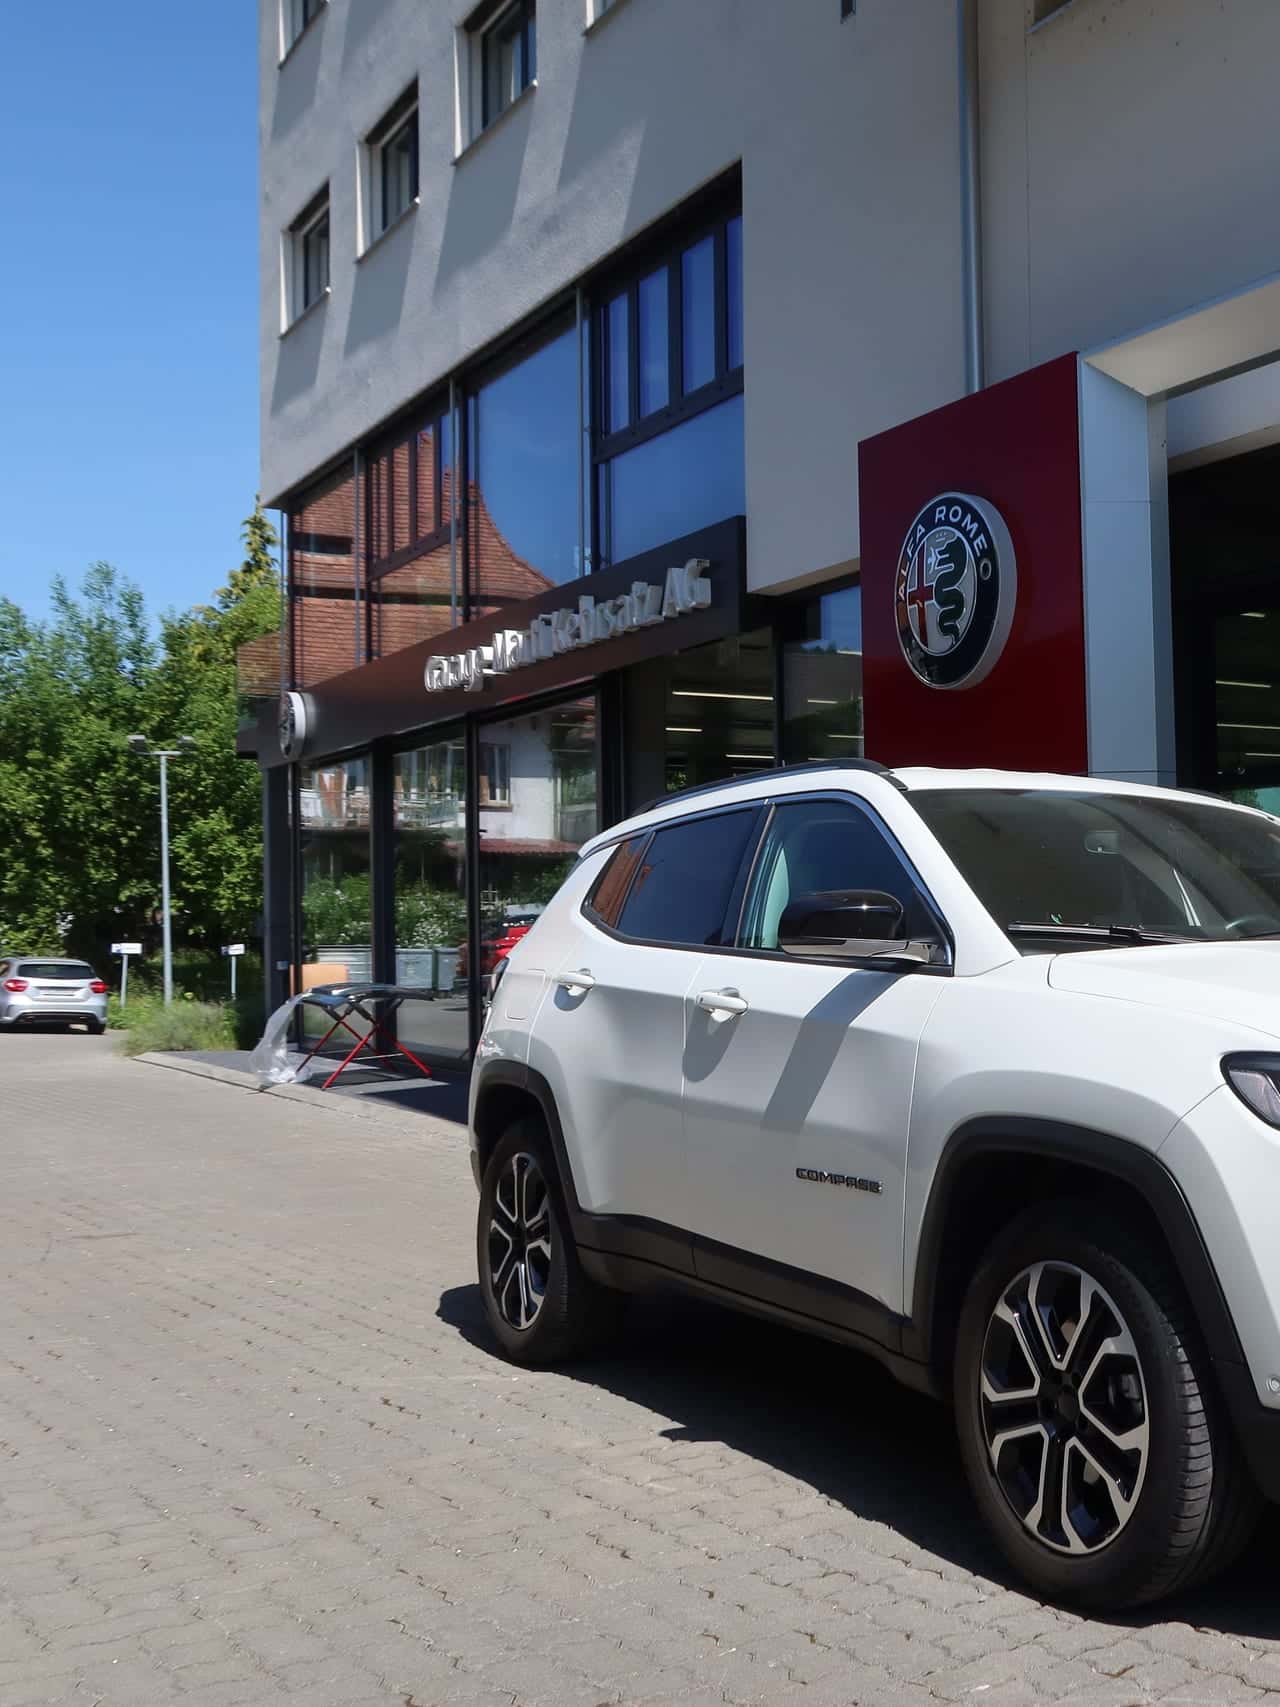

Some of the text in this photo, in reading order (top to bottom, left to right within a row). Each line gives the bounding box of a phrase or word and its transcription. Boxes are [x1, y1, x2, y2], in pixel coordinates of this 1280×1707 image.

[897, 505, 993, 601] ALFA ROMEO
[425, 647, 493, 692] Garage
[662, 558, 712, 618] AG
[796, 1167, 882, 1193] COMPASS
